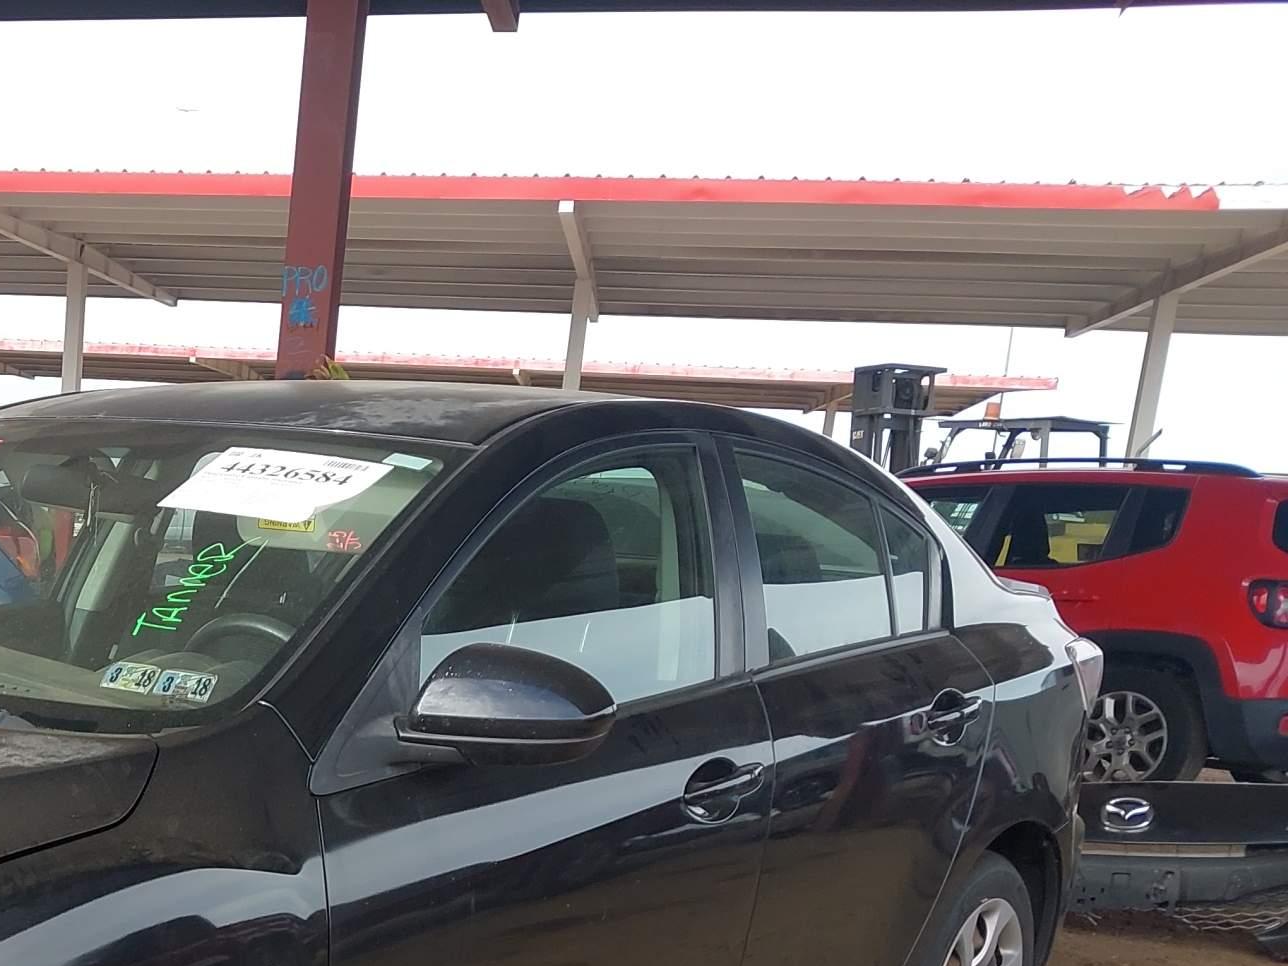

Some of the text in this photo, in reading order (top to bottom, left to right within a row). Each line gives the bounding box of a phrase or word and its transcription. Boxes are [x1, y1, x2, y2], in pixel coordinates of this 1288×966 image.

[281, 265, 328, 297] PRO
[220, 460, 353, 486] 44326584
[109, 667, 156, 688] 3 18
[162, 676, 212, 697] 3 18
